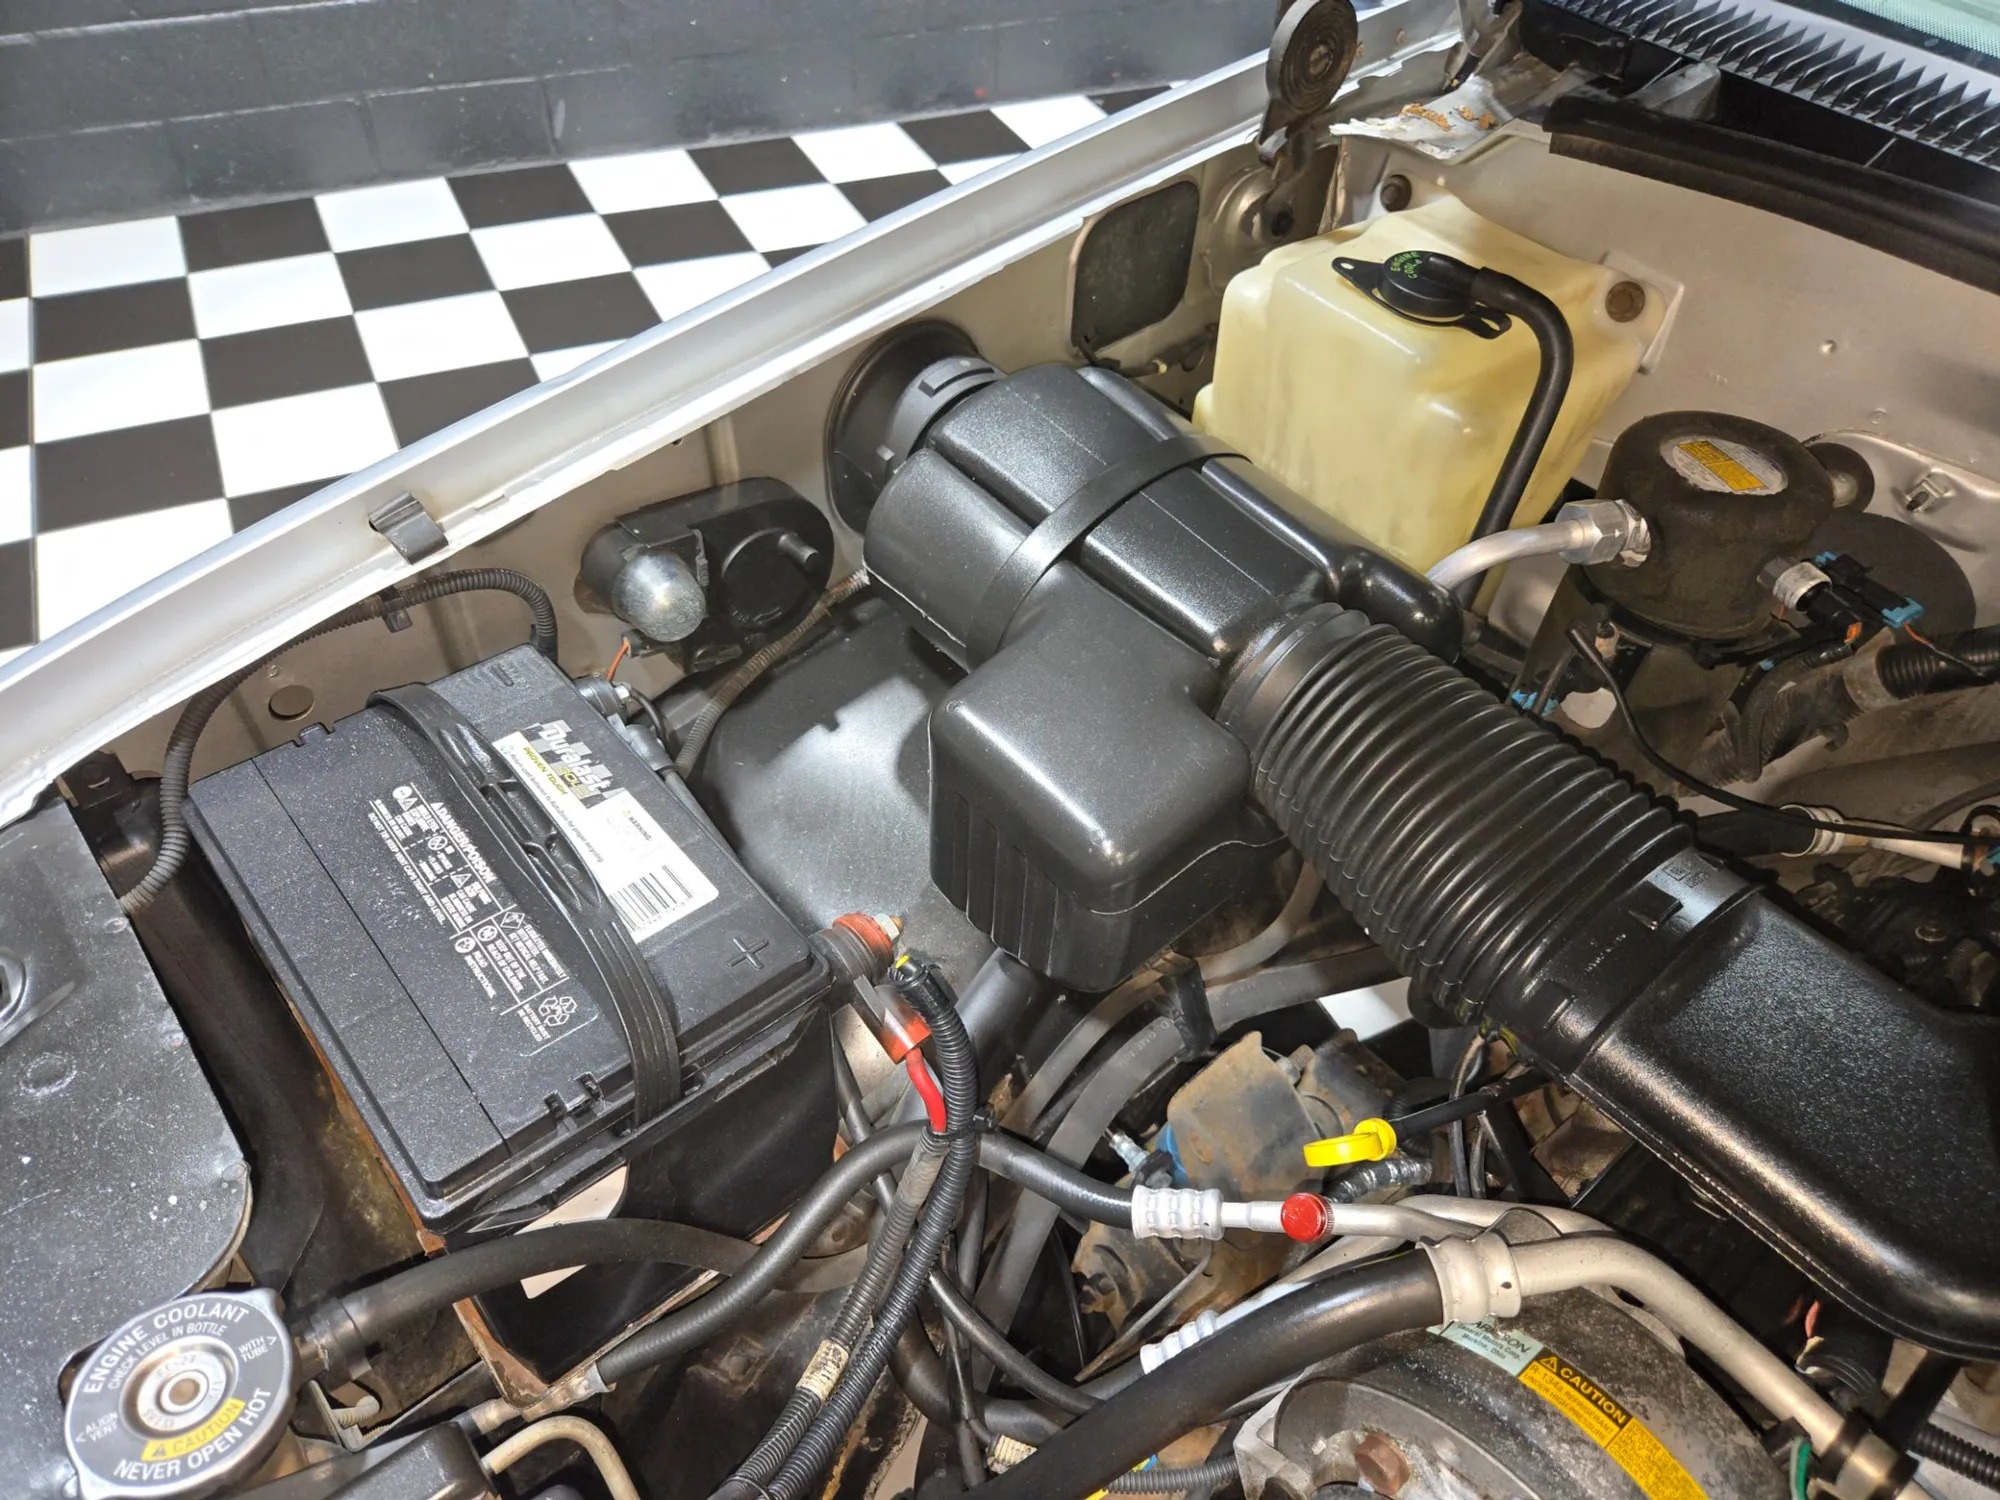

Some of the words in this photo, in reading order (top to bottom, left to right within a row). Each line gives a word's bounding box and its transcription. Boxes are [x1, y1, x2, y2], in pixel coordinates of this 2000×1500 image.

[523, 746, 548, 775] PROVEN
[546, 772, 568, 796] TOUGH
[538, 721, 611, 791] Duralast
[560, 766, 591, 796] GOLD
[437, 805, 497, 881] DANGER/POISON
[83, 1326, 148, 1393] ENGINE
[153, 1303, 249, 1329] COOLANT
[108, 1357, 136, 1389] CHECK
[139, 1333, 169, 1357] LEVEL
[172, 1324, 184, 1336] IN
[186, 1322, 228, 1337] BOTTLE
[238, 1336, 266, 1354] WITH
[241, 1345, 269, 1363] TUBE
[1457, 1323, 1481, 1337] General
[1481, 1333, 1504, 1350] Motors
[1503, 1346, 1522, 1361] Corp.
[1489, 1346, 1506, 1360] Ohio
[1523, 1372, 1550, 1394] UNDER
[1548, 1391, 1568, 1408] HIGH
[1566, 1405, 1607, 1441] PRESSURE
[1560, 1366, 1625, 1424] CAUTION
[1562, 1389, 1615, 1435] REFRIGERANT
[85, 1412, 119, 1433] ALIGN
[89, 1421, 119, 1442] VENT
[114, 1459, 181, 1481] NEVER
[187, 1428, 243, 1469] OPEN
[239, 1388, 271, 1427] HOT
[172, 1403, 240, 1453] CAUTION
